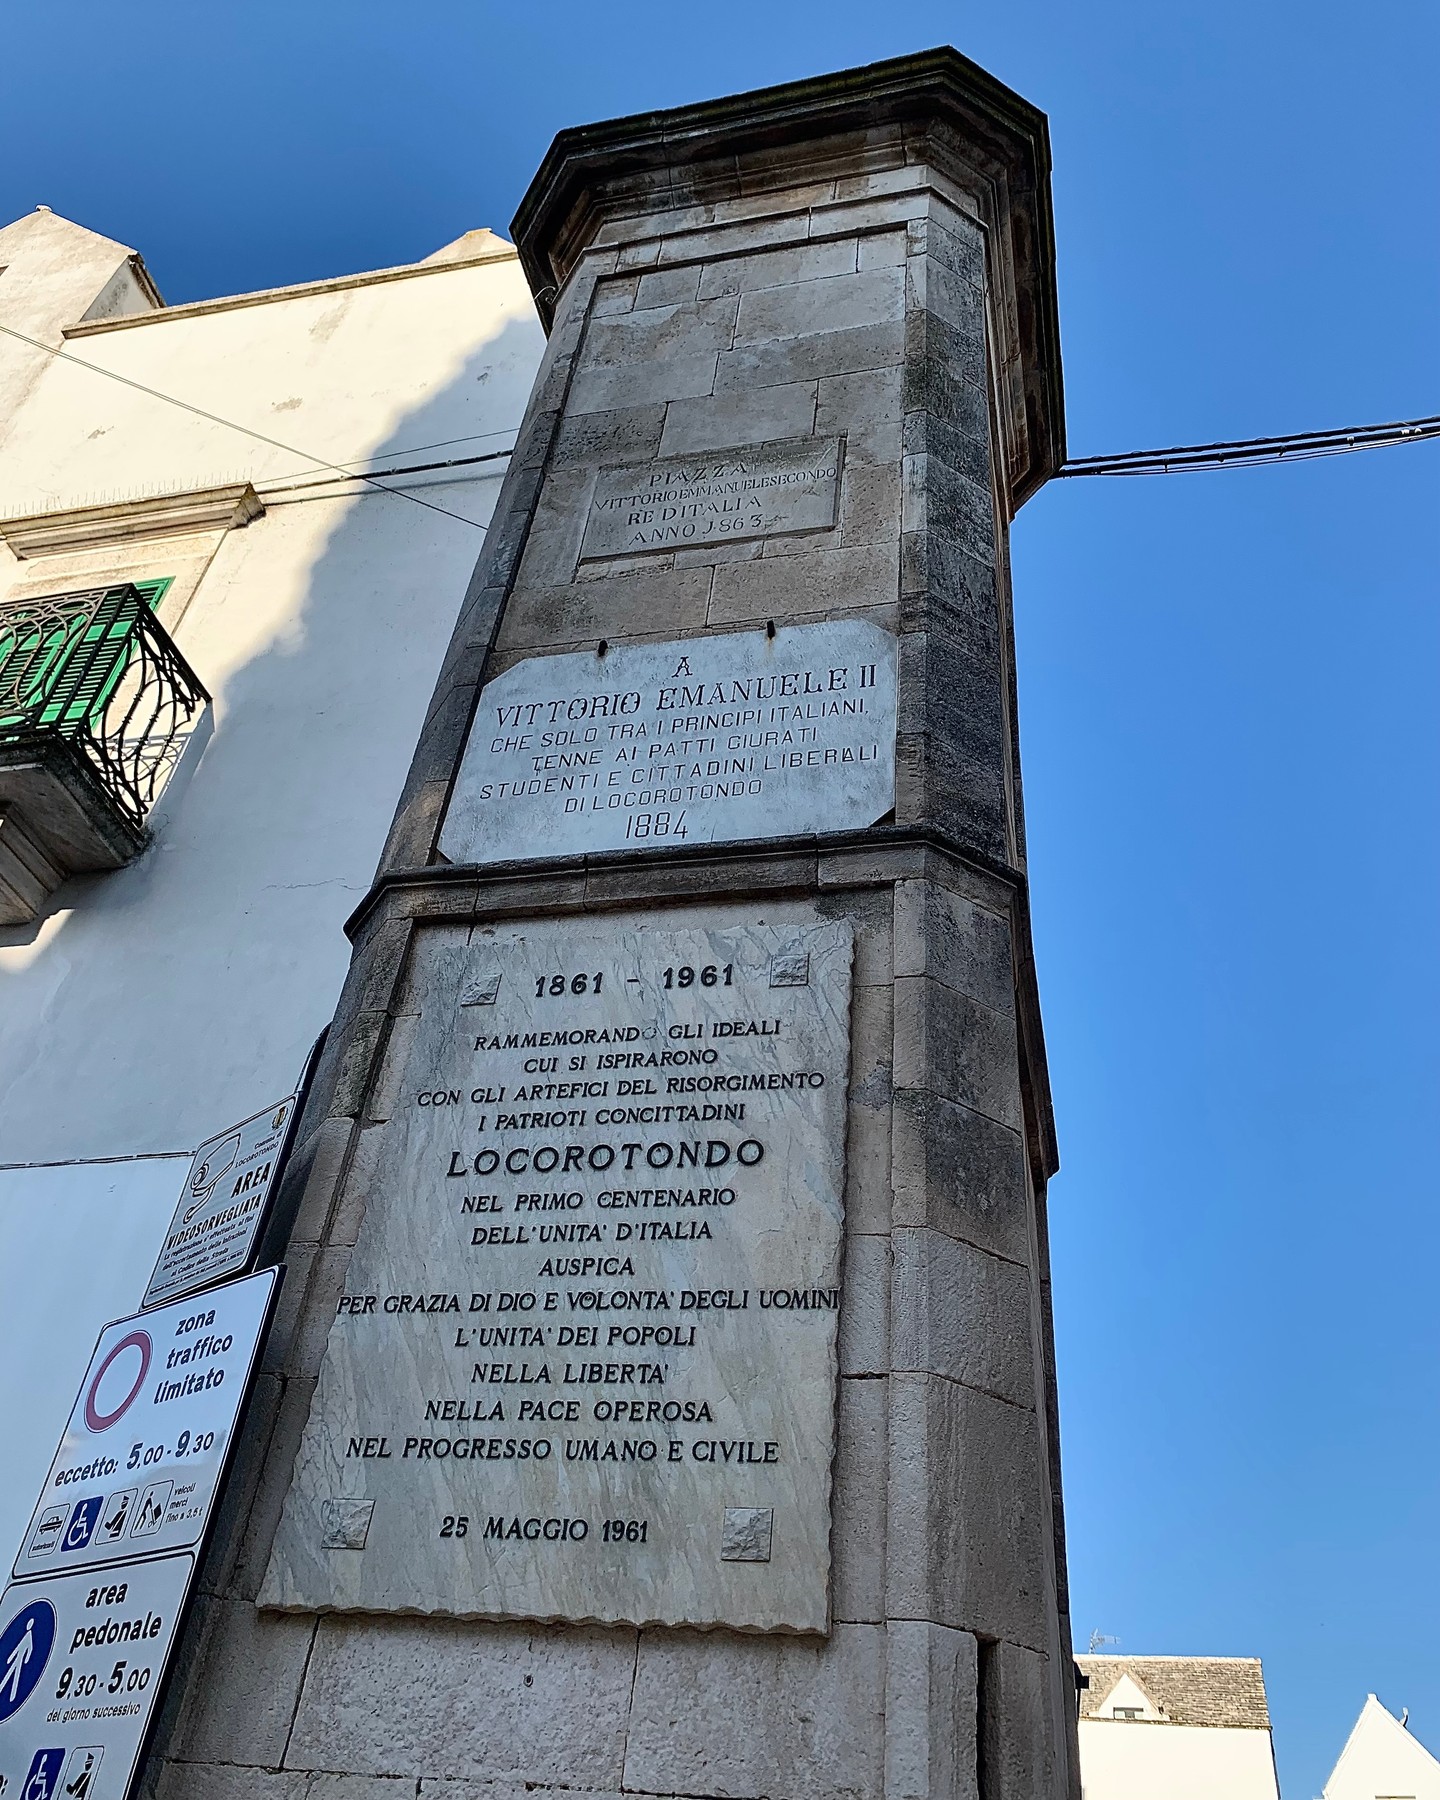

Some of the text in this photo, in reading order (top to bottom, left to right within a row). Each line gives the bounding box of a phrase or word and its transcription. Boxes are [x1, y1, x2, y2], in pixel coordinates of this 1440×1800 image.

[649, 462, 747, 487] PIAZZA
[627, 511, 654, 526] RE
[629, 523, 696, 545] ANNO
[672, 656, 693, 678] A
[496, 664, 877, 727] VITTORIO EMANUELE II
[490, 698, 869, 753] CHE SOLO TRA I PRINCIPI ITALIANI,
[531, 750, 603, 771] TENNE
[615, 747, 637, 762] AI
[649, 738, 715, 758] PATTI
[479, 745, 877, 799] STUDENTI E CITTADINI LIBERALI
[564, 779, 762, 813] DI LOCOROTONDO
[626, 810, 688, 839] 1884
[534, 971, 604, 998] 1861
[663, 963, 735, 990] 1961
[473, 1019, 782, 1051] RAMMEMORANDO GLI IDEALI
[524, 1049, 718, 1073] CUI SI ISPIRARONO
[417, 1072, 825, 1107] CON GLI ARTEFICI DEL RISORGIMENTO
[478, 1103, 746, 1132] I PATRIOTI CONCITTADINI
[235, 1141, 279, 1168] LOCOROTONDO
[447, 1139, 765, 1177] LOCOROTONDO
[230, 1161, 272, 1198] AREA
[461, 1188, 736, 1213] NEL PRIMO CENTENARIO
[165, 1193, 262, 1250] VIDEOSORVEGLIATA
[615, 1221, 713, 1242] D'ITALIA
[538, 1257, 635, 1277] AUSPICA
[336, 1289, 840, 1315] PER GRAZIA DI DIO E VOLONTA' DEGLI UOMINI
[174, 1309, 216, 1336] zona
[558, 1327, 598, 1347] DEI
[606, 1326, 696, 1347] POPOLI
[166, 1334, 233, 1369] traffico
[153, 1367, 225, 1404] limitato
[471, 1364, 670, 1385] NELLA LIBERTA'
[424, 1401, 713, 1423] NELLA PACE OPEROSA
[54, 1455, 119, 1487] eccetto:
[126, 1441, 163, 1471] 5,00
[174, 1430, 215, 1458] 9,30
[346, 1438, 780, 1464] NEL PROGRESSO UMANO E CIVILE
[174, 1482, 197, 1495] veicoli
[169, 1497, 189, 1509] merci
[165, 1512, 179, 1523] fino
[439, 1516, 648, 1542] 25 MAGGIO 1961
[85, 1583, 128, 1609] area
[69, 1611, 162, 1654] pedonale
[55, 1667, 97, 1700] 9,30
[108, 1660, 151, 1695] 5,00
[46, 1701, 141, 1723] del giorno successivo
